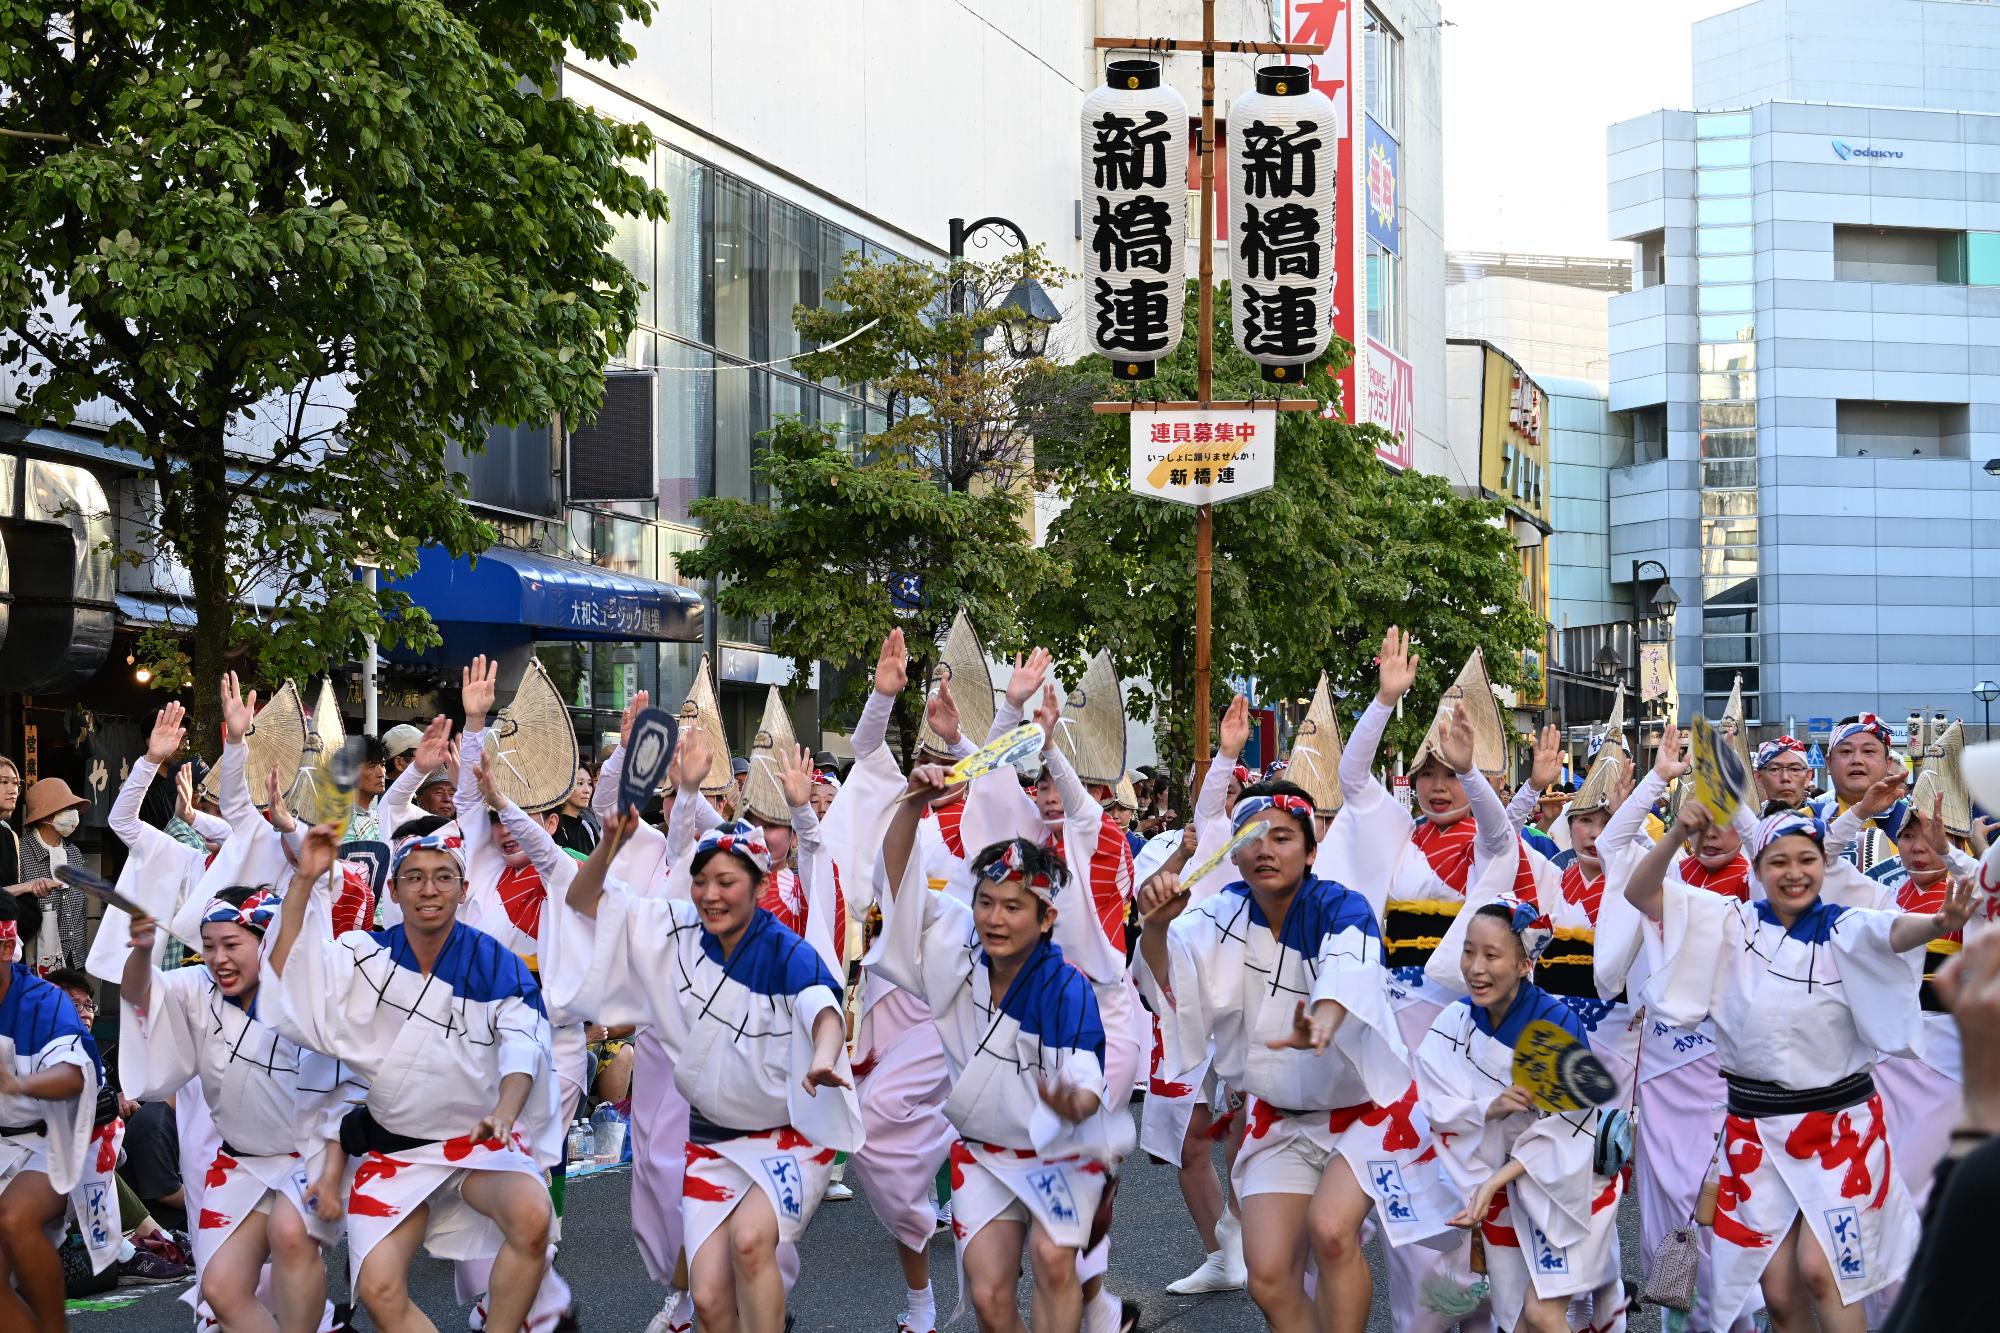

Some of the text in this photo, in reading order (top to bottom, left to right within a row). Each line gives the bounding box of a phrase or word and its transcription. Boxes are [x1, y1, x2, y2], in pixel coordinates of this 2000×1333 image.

[1093, 110, 1172, 352] 新橋連
[1241, 120, 1322, 357] 新橋連
[1150, 422, 1256, 443] 連員募集中
[1147, 452, 1256, 463] いっしょに踊りませんか！
[1169, 467, 1236, 486] 新橋連
[571, 599, 660, 633] 大和ミュージック劇場
[1376, 1167, 1411, 1219] 大和
[1834, 1214, 1861, 1274] 大和
